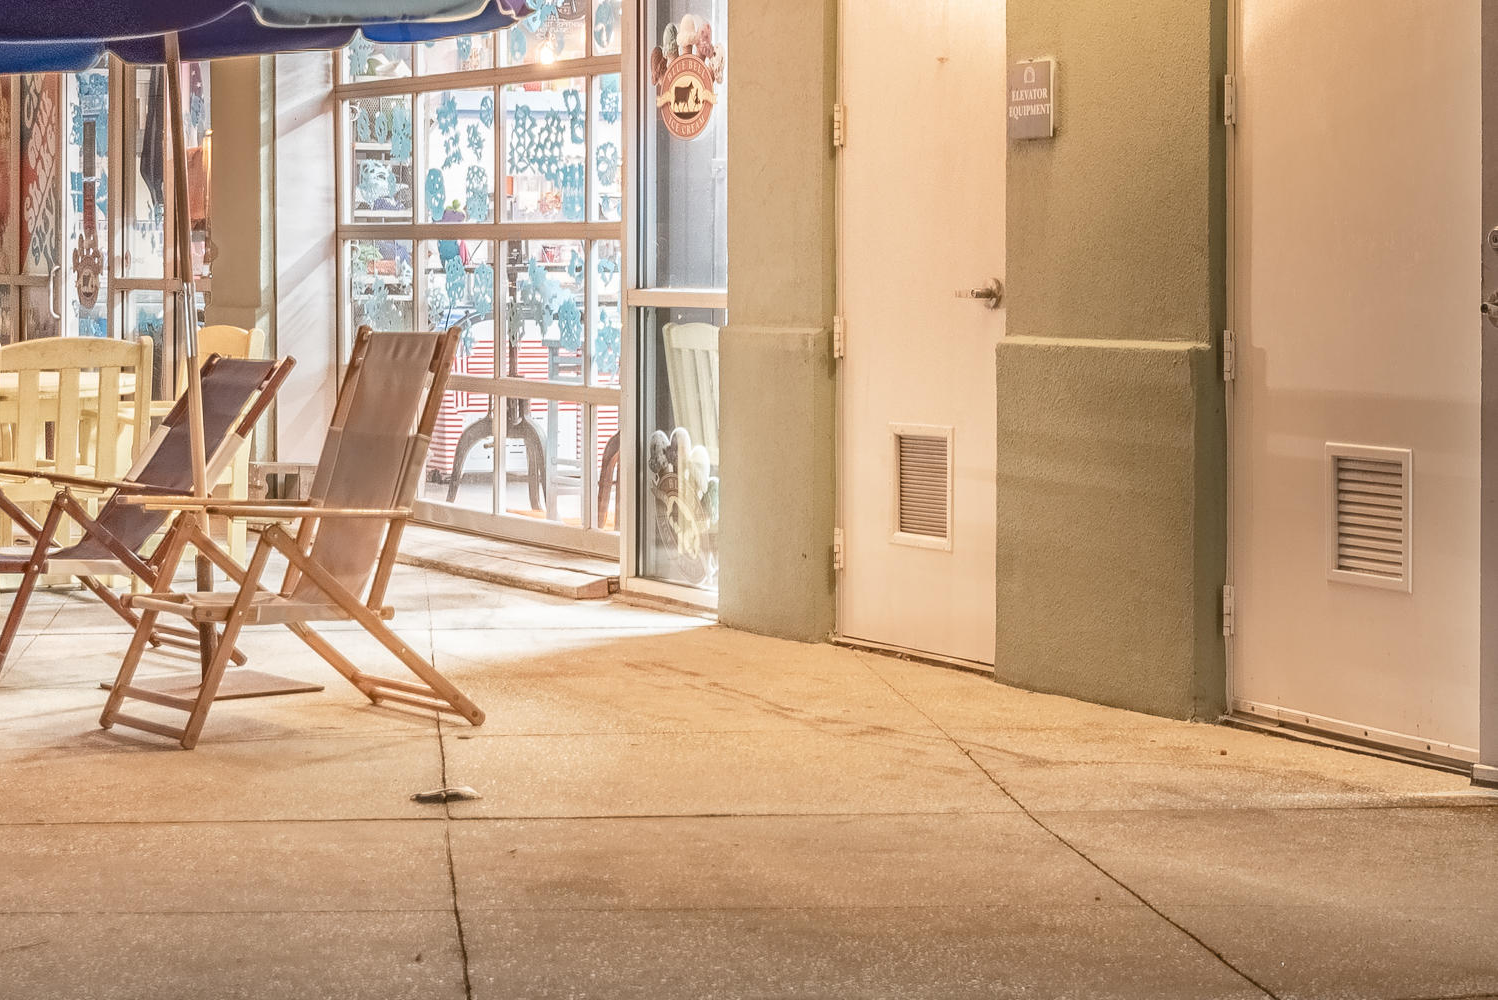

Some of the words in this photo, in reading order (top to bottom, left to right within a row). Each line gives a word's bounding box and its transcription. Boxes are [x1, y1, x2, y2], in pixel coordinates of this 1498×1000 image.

[688, 60, 707, 79] BELL
[1011, 88, 1048, 102] ELEVATOR
[1009, 103, 1051, 120] EQUIPMENT
